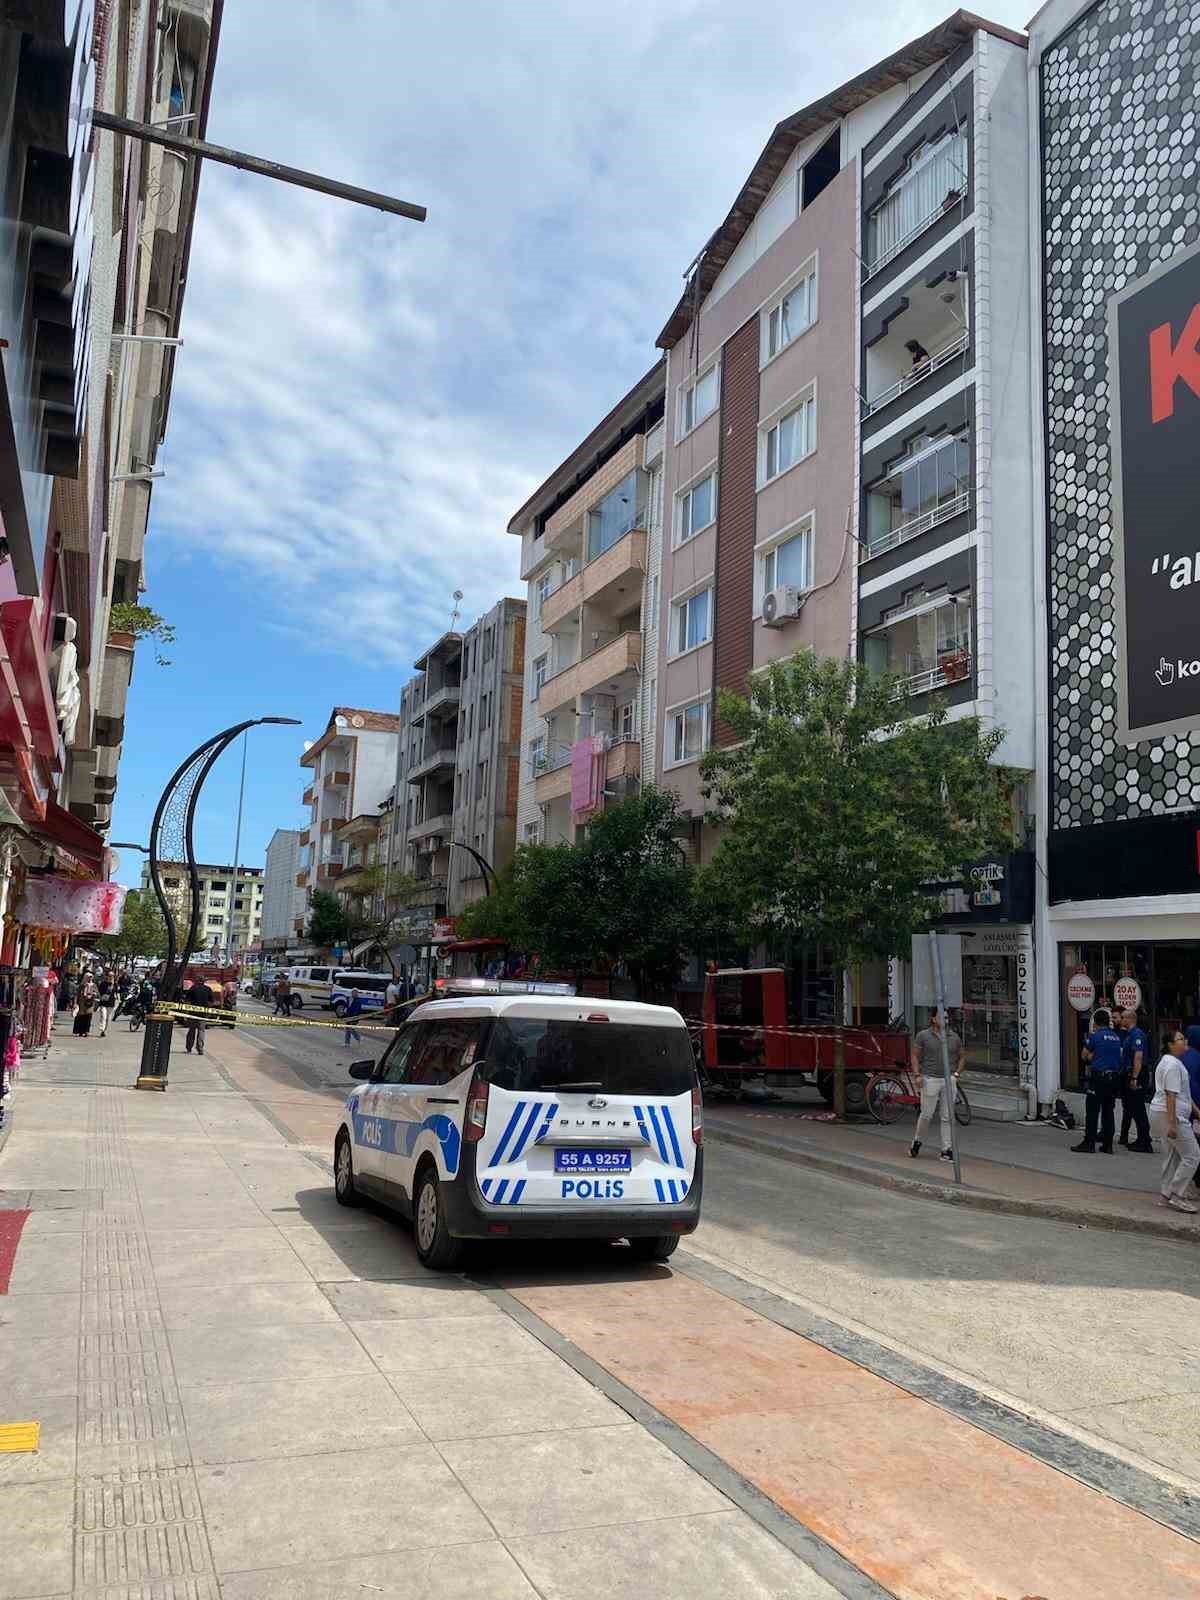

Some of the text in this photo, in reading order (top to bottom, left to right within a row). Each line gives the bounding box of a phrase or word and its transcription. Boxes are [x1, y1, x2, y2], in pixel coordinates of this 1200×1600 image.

[561, 1154, 628, 1165] 55 A 9257
